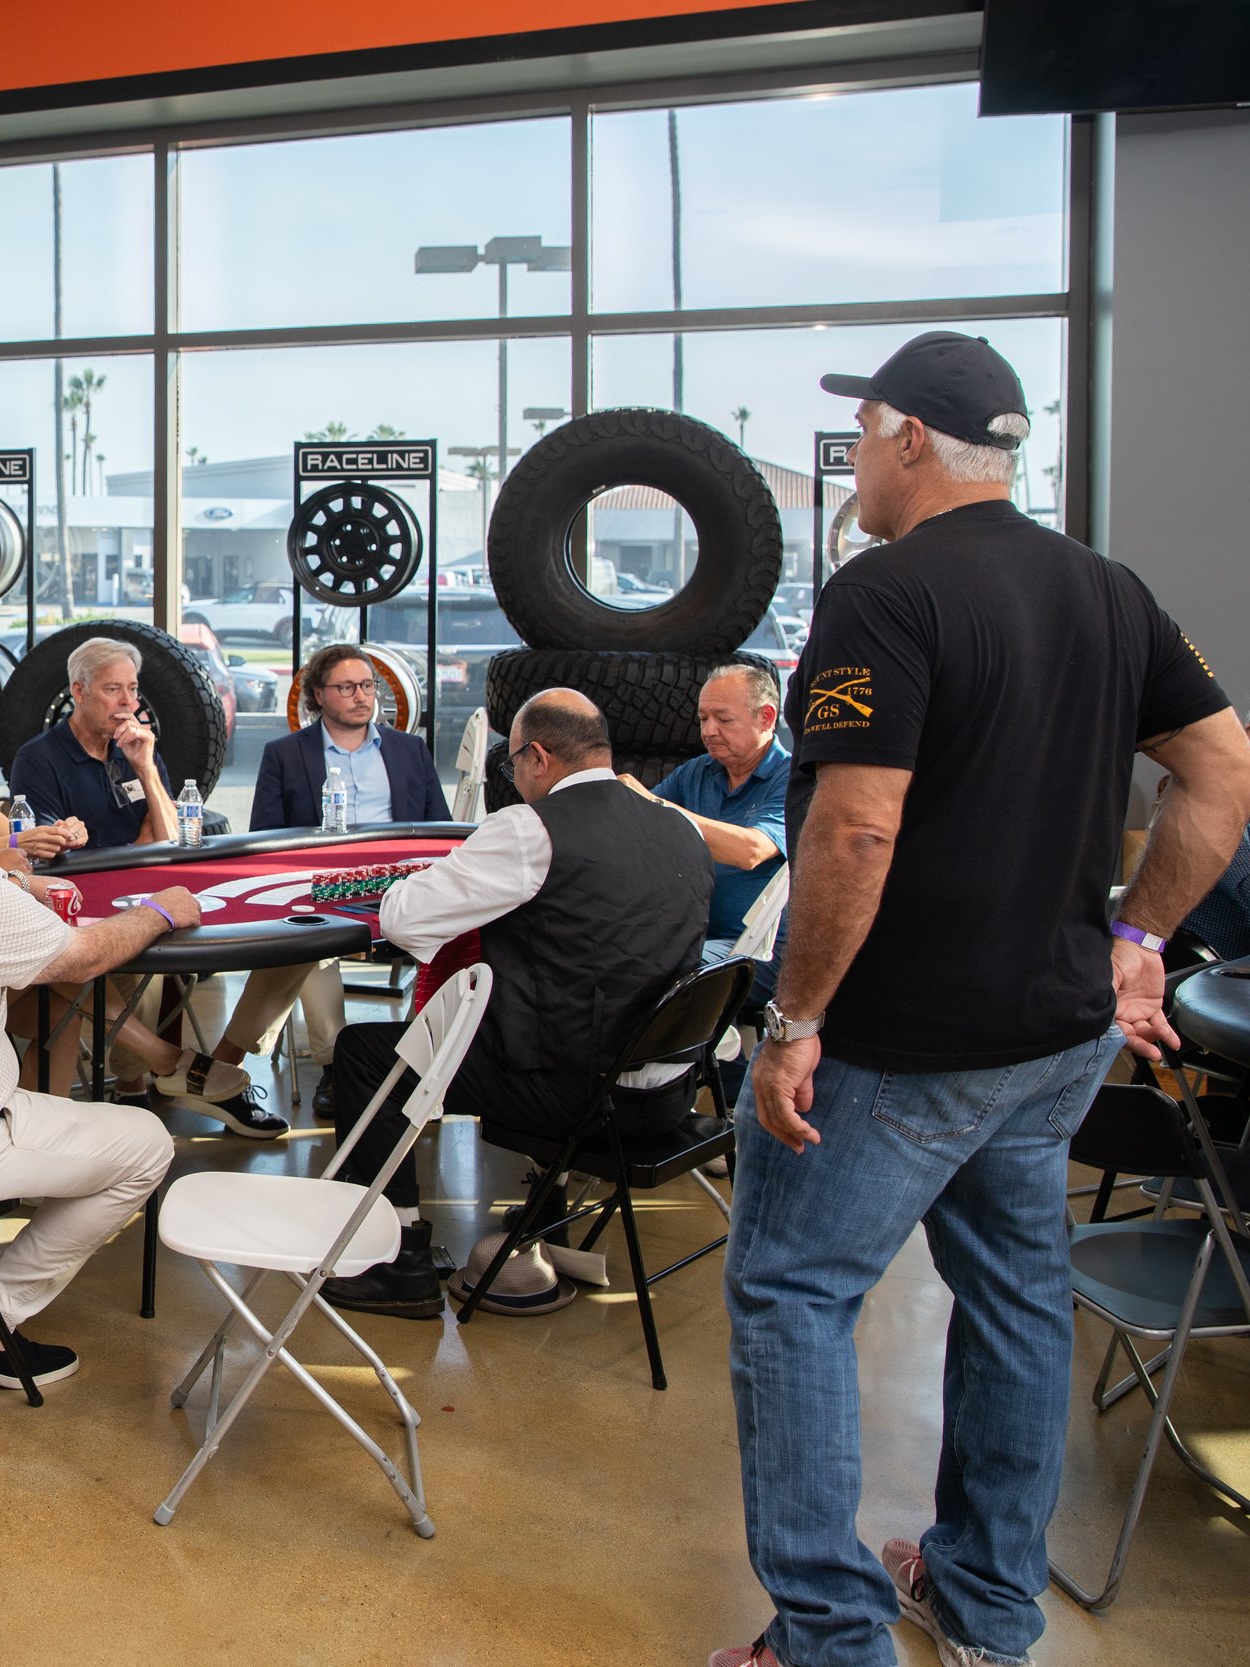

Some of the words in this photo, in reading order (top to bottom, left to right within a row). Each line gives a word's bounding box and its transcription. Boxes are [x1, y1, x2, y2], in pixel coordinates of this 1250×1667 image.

[307, 452, 425, 471] RACELINE
[833, 667, 871, 676] STYLE
[847, 687, 873, 696] 1776
[817, 703, 840, 720] GS
[833, 720, 871, 729] DEFEND
